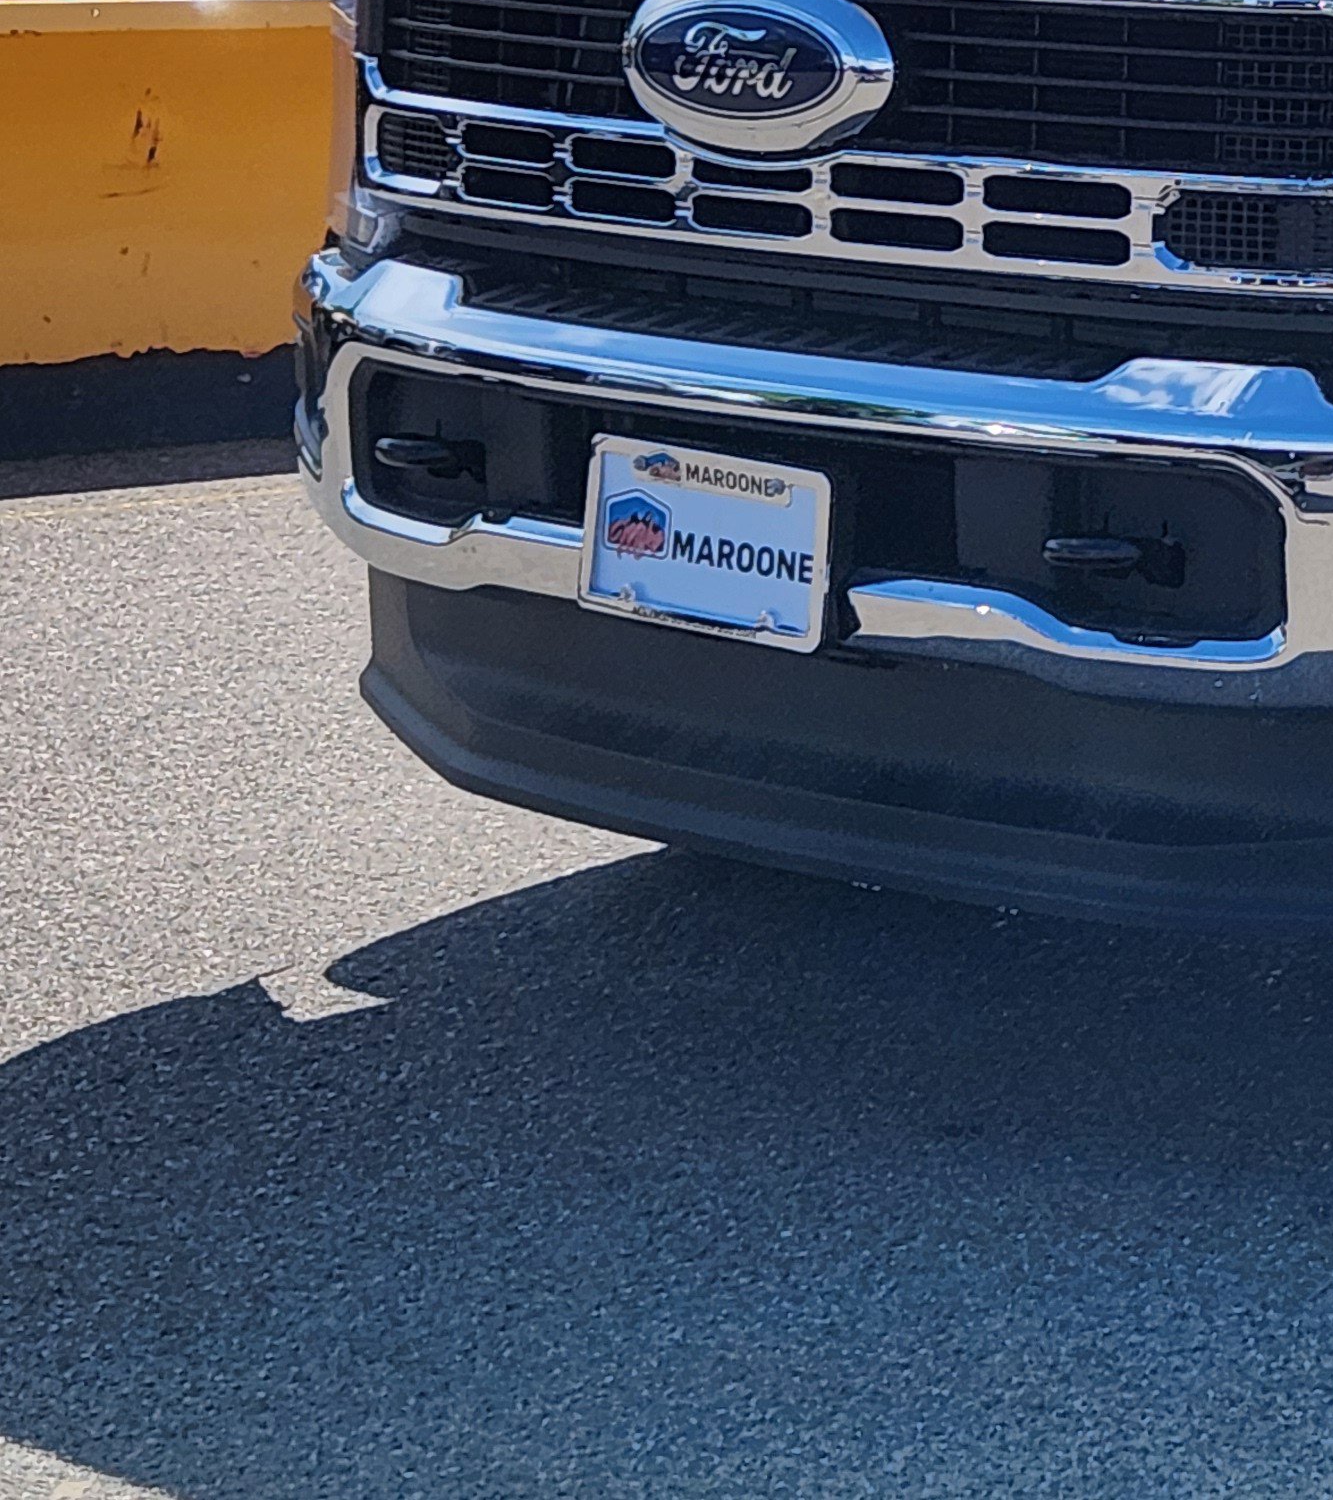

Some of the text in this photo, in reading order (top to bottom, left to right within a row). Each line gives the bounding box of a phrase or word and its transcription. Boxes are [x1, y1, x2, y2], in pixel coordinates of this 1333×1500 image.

[672, 20, 798, 99] Ford
[685, 462, 776, 498] MAROONE
[671, 529, 815, 585] MAROONE
